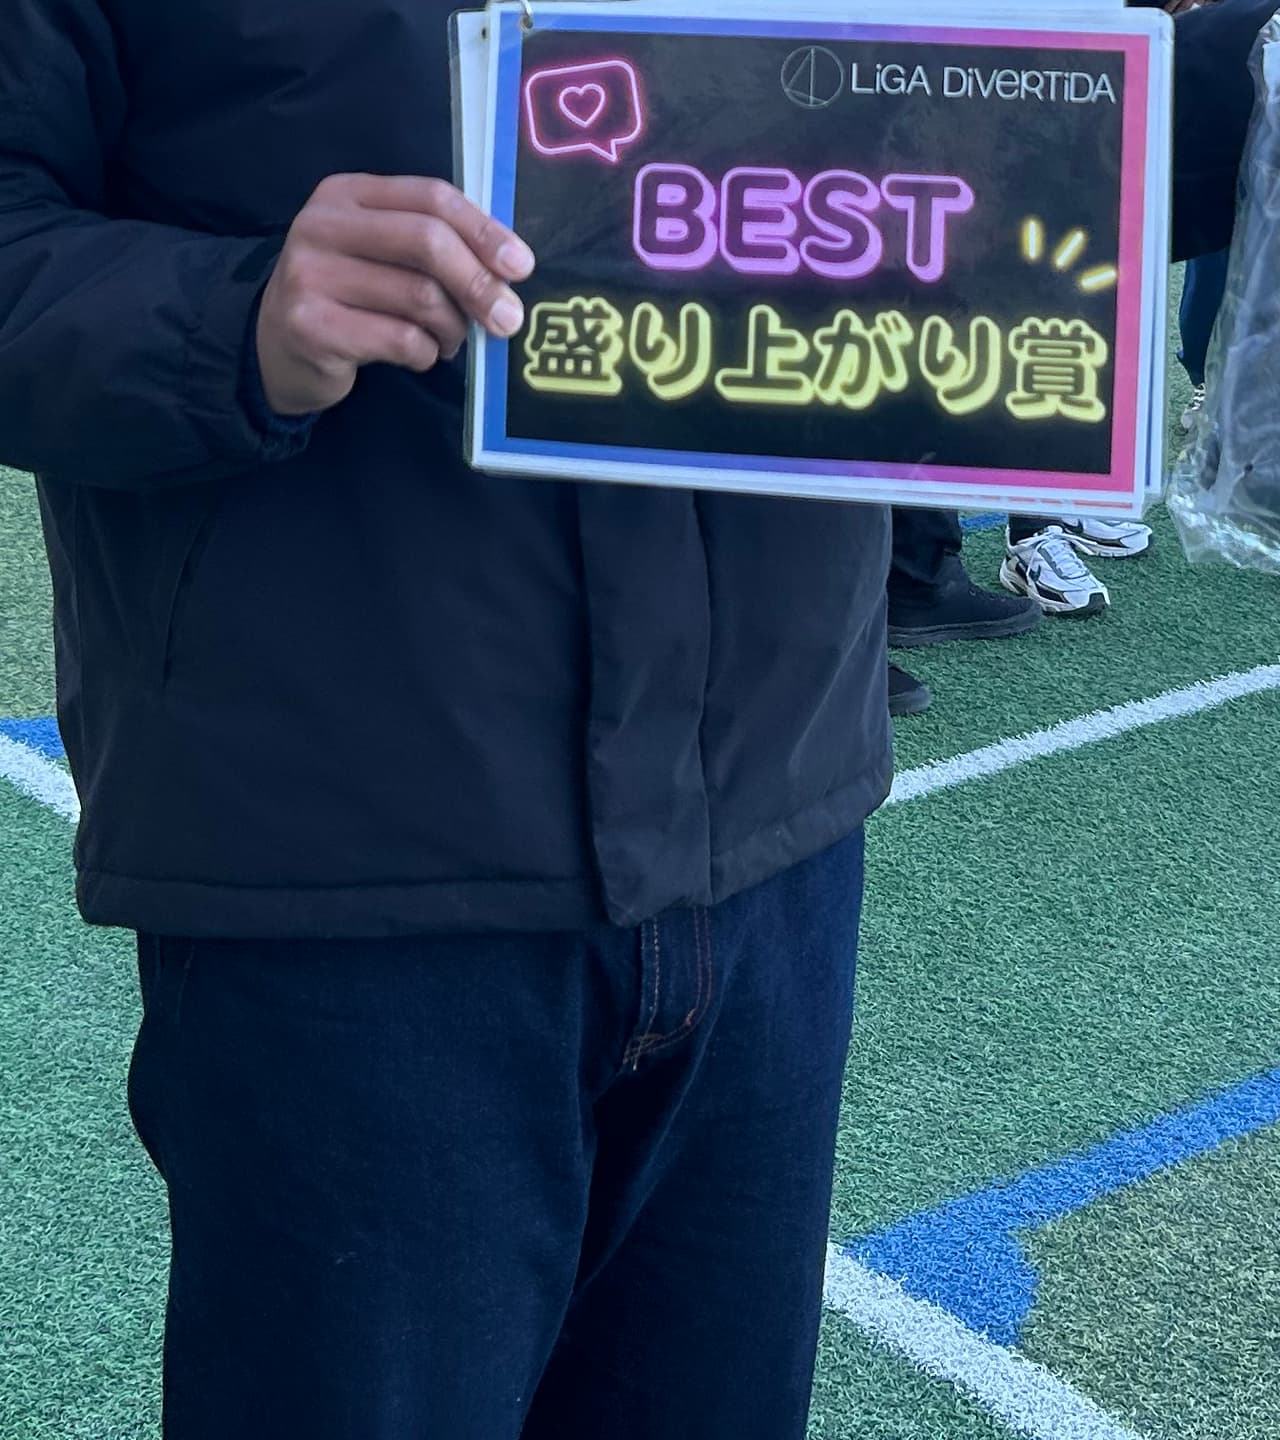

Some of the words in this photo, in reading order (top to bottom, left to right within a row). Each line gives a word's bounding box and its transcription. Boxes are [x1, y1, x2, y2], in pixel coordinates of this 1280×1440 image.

[632, 162, 975, 283] BEST
[522, 296, 1110, 424] 盛り上がり賞
